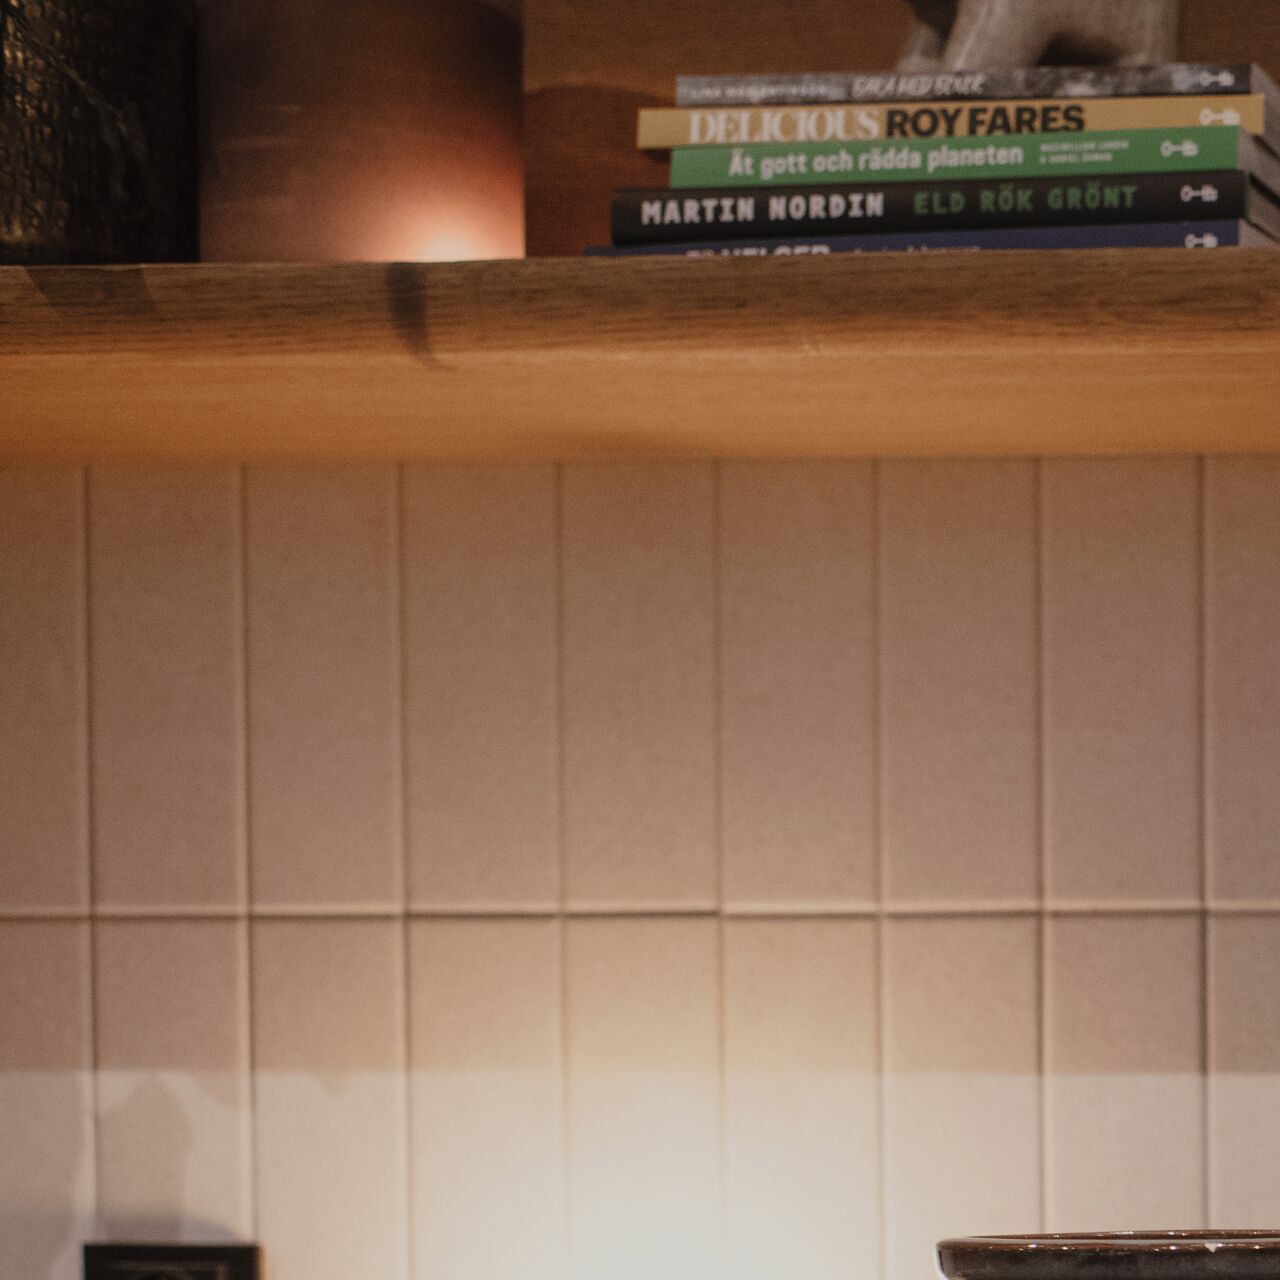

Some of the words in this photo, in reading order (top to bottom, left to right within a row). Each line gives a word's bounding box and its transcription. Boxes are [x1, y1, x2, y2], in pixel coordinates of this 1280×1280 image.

[689, 109, 880, 144] DELICIOUS
[887, 108, 962, 138] ROY
[969, 104, 1085, 136] FARES
[760, 152, 806, 180] gott
[812, 149, 852, 173] och
[859, 148, 921, 171] rädda
[927, 144, 1023, 173] planeten
[641, 199, 754, 225] MARTIN
[768, 193, 884, 220] NORDIN
[914, 191, 966, 215] ELD
[979, 184, 1032, 212] RÖK
[1047, 182, 1138, 211] GRÖNT
